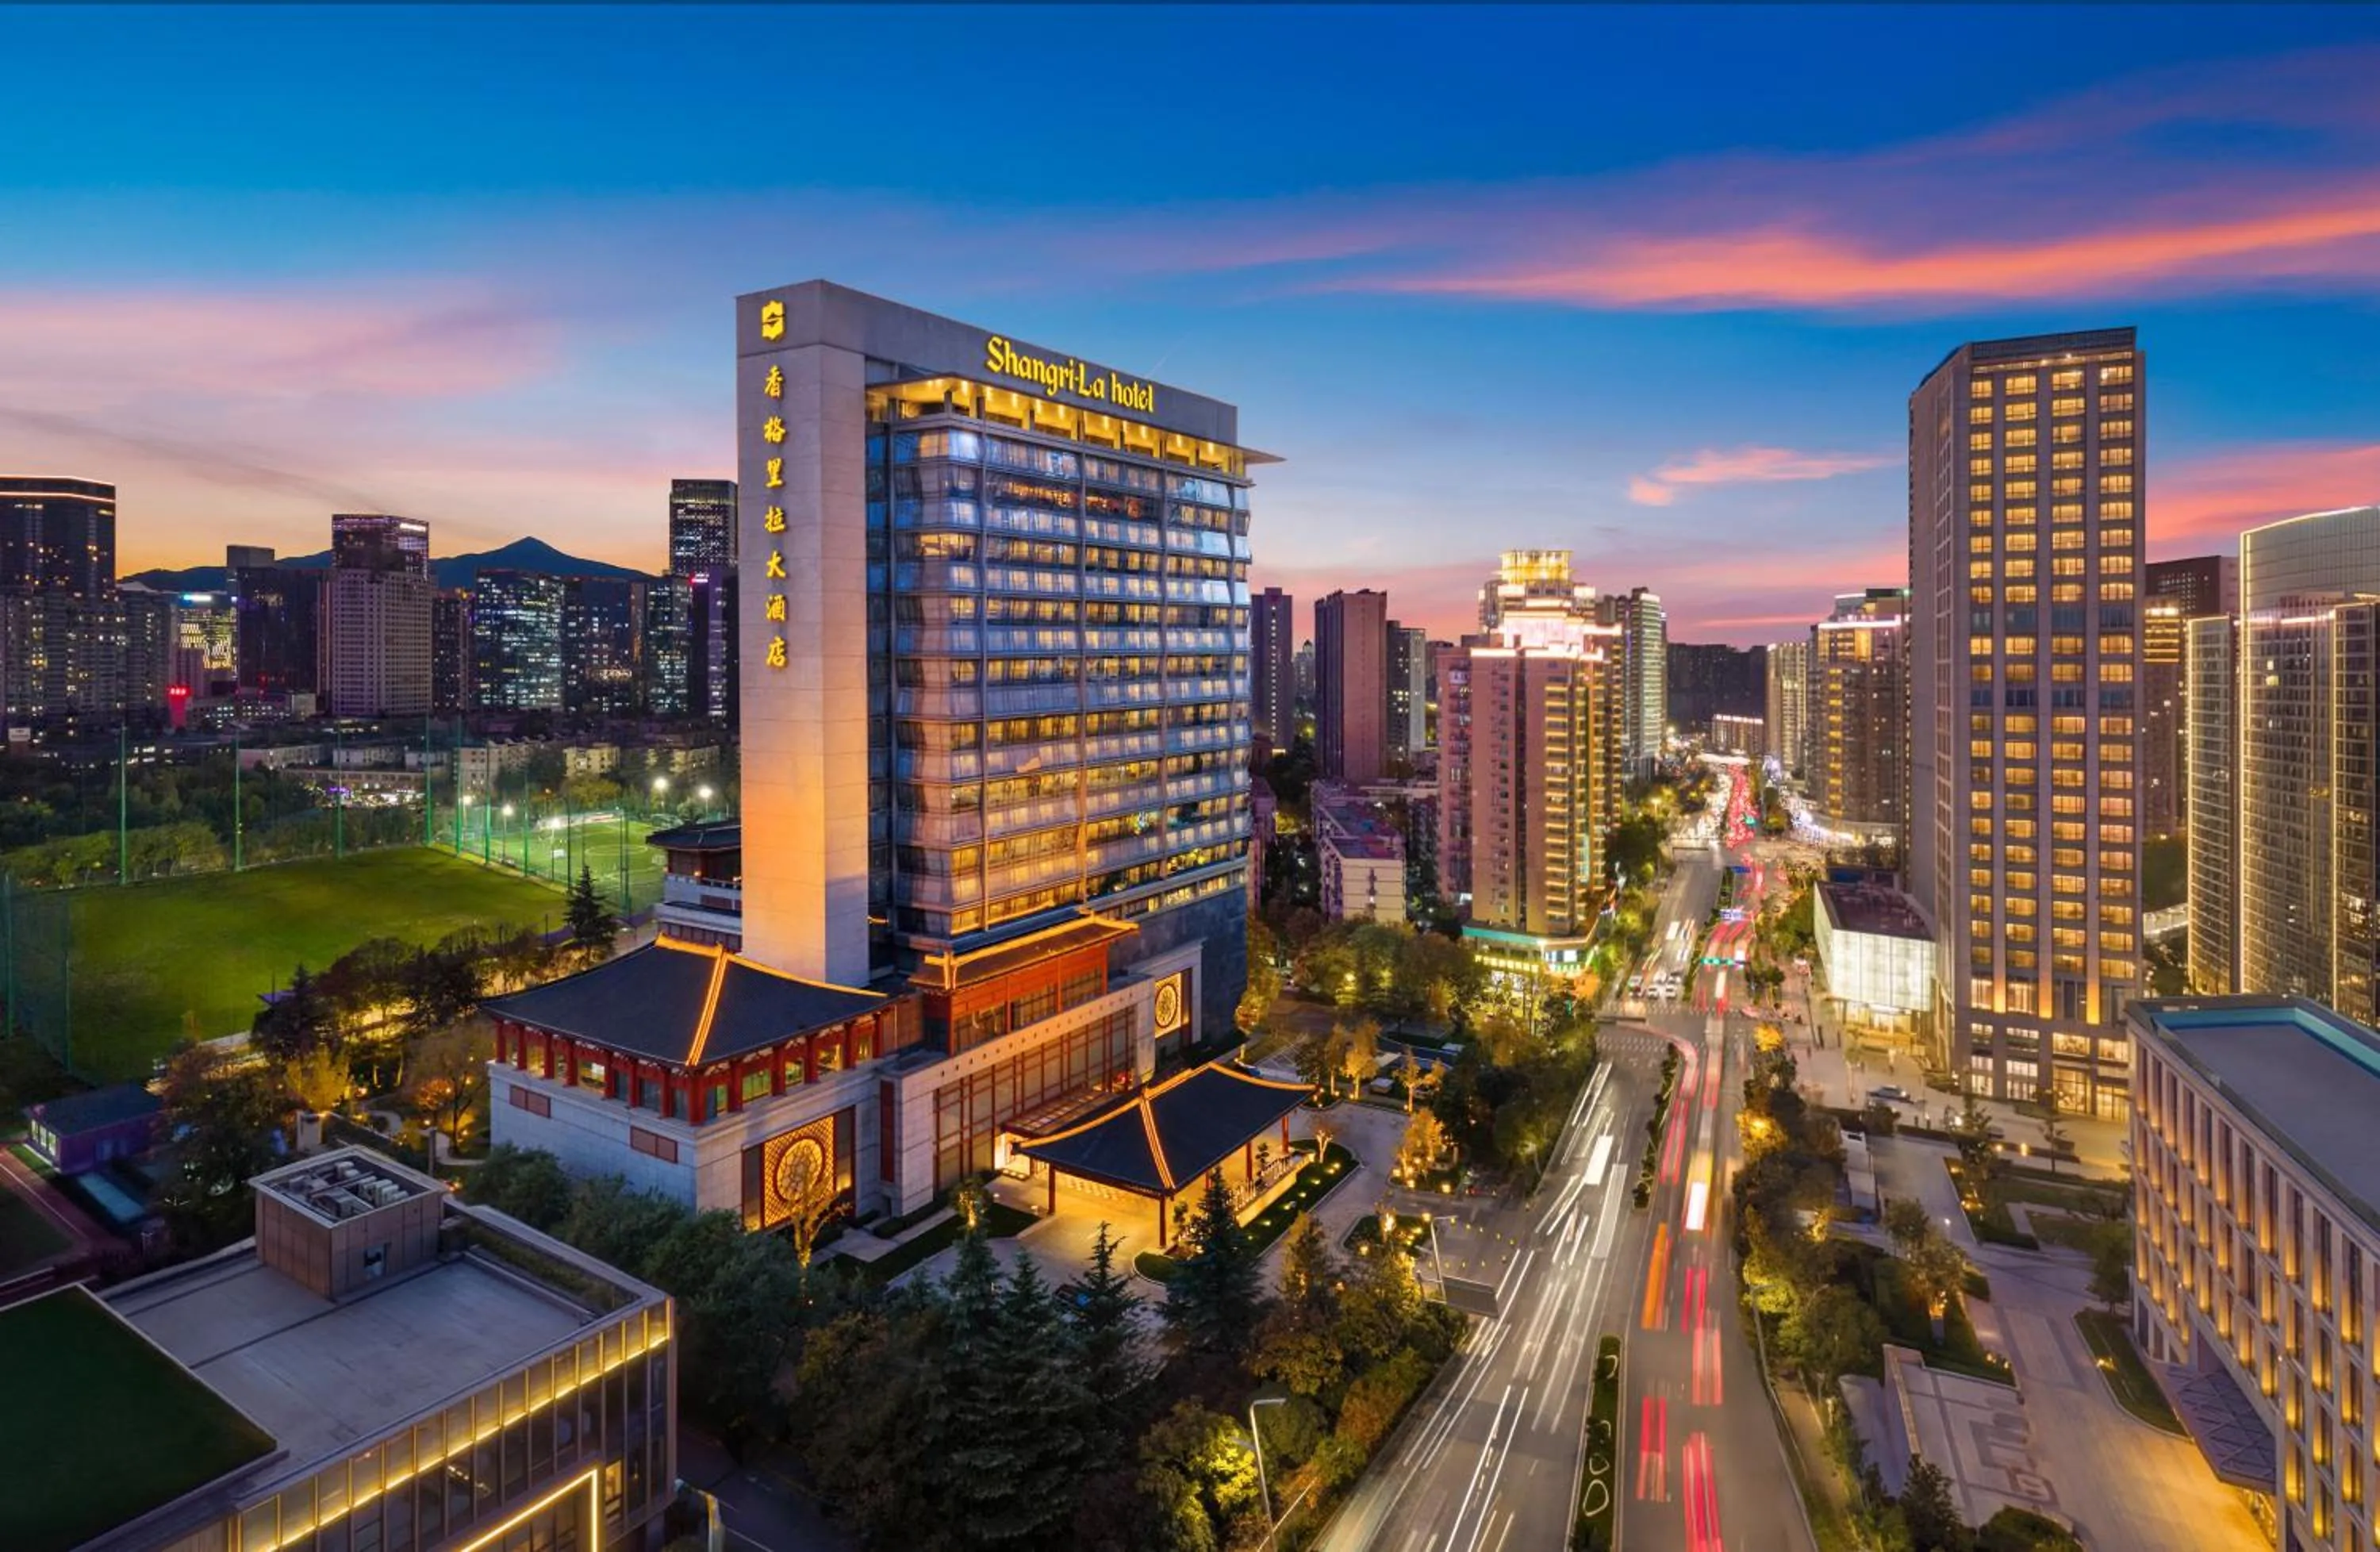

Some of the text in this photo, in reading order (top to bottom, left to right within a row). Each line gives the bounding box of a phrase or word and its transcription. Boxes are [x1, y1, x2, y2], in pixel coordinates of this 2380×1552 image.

[987, 336, 1154, 413] Shangri-La hotel
[763, 364, 787, 667] 香格里拉大酒店
